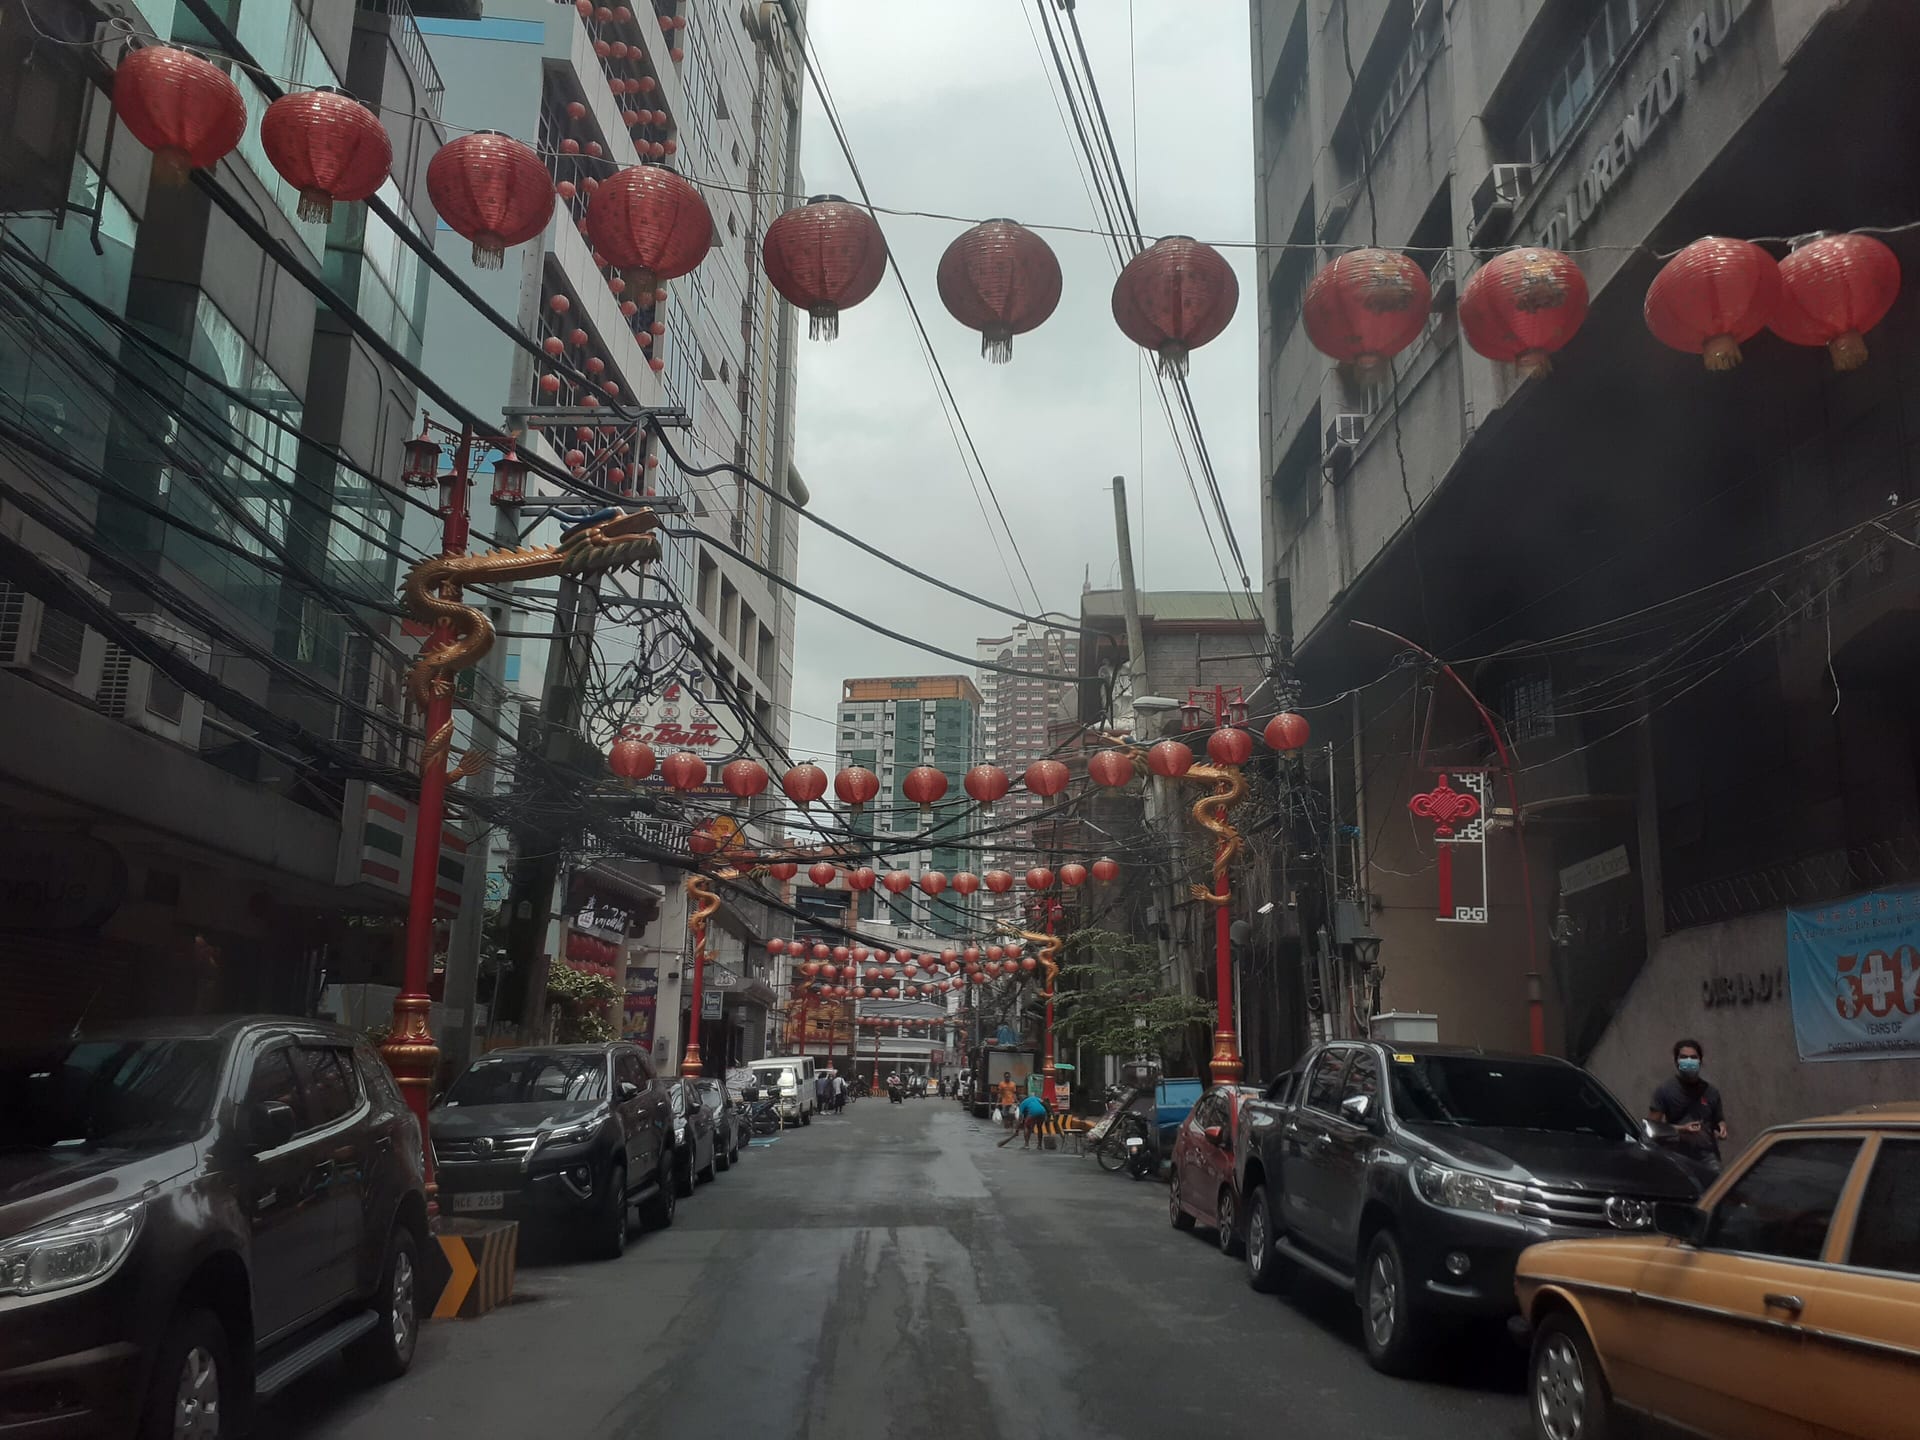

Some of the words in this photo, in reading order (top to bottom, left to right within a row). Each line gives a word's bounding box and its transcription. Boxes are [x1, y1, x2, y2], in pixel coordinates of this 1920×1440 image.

[1566, 54, 1680, 238] LORENZO
[1866, 1023, 1890, 1035] YEARS
[1891, 1021, 1902, 1033] OF
